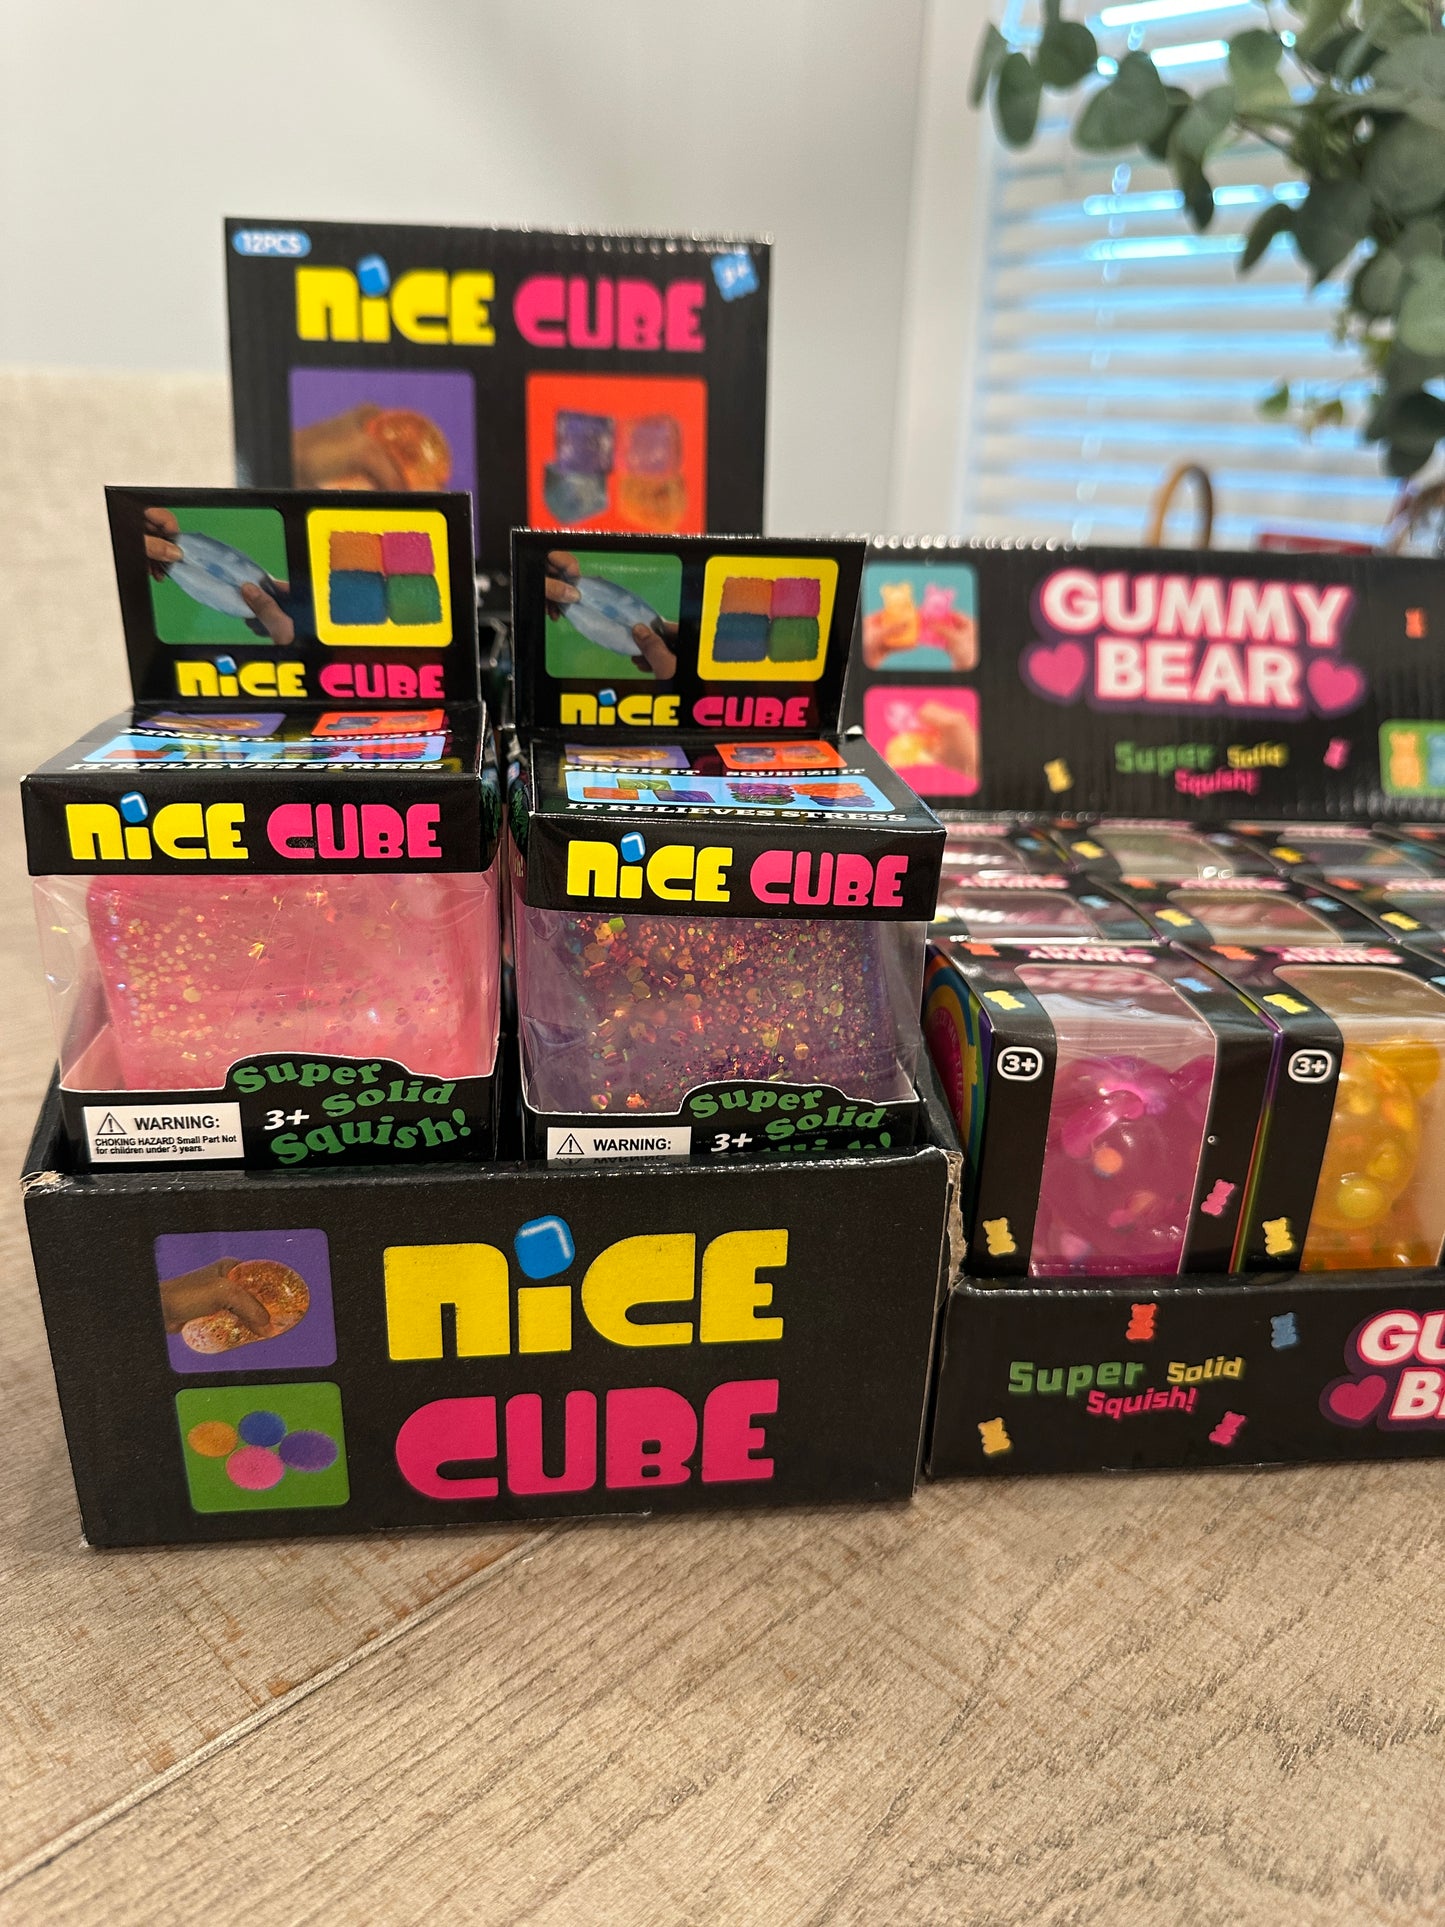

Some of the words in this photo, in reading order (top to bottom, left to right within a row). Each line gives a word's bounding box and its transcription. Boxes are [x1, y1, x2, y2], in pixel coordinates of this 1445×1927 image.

[513, 274, 706, 352] CUBE
[1039, 568, 1351, 646] GUMMY
[319, 663, 446, 699] CUBE
[1095, 635, 1302, 708] BEAR
[692, 696, 810, 728] CUBE
[66, 762, 112, 771] IT
[108, 762, 302, 771] RELIEVES
[303, 762, 444, 770] STRESS
[562, 764, 673, 775] PINCH
[675, 768, 700, 776] IT
[565, 802, 605, 812] IT
[606, 803, 778, 818] RELIEVES
[781, 807, 907, 823] STRESS
[266, 803, 442, 859] CUBE
[750, 849, 909, 907] CUBE
[232, 1059, 382, 1093] Super
[1003, 1054, 1036, 1074] 3+
[1294, 1056, 1326, 1076] 3+
[321, 1080, 457, 1118] Solid
[689, 1089, 823, 1120] Super
[134, 1115, 220, 1131] WARNING:
[263, 1109, 310, 1131] 3+
[269, 1108, 472, 1165] Squish!
[764, 1105, 887, 1141] Solid
[95, 1137, 136, 1147] CHOKING
[138, 1137, 175, 1146] HAZARD
[177, 1135, 201, 1145] Small
[202, 1135, 220, 1144] Part
[222, 1134, 237, 1143] Not
[96, 1147, 108, 1155] for
[110, 1146, 143, 1155] children
[146, 1145, 170, 1154] under
[172, 1145, 178, 1153] 3
[179, 1145, 205, 1155] years.
[593, 1138, 671, 1151] WARNING:
[711, 1132, 753, 1153] 3+
[1007, 1360, 1146, 1397] Super
[1166, 1355, 1246, 1385] Solid
[1086, 1385, 1200, 1421] Squish!
[396, 1379, 779, 1500] CUBE
